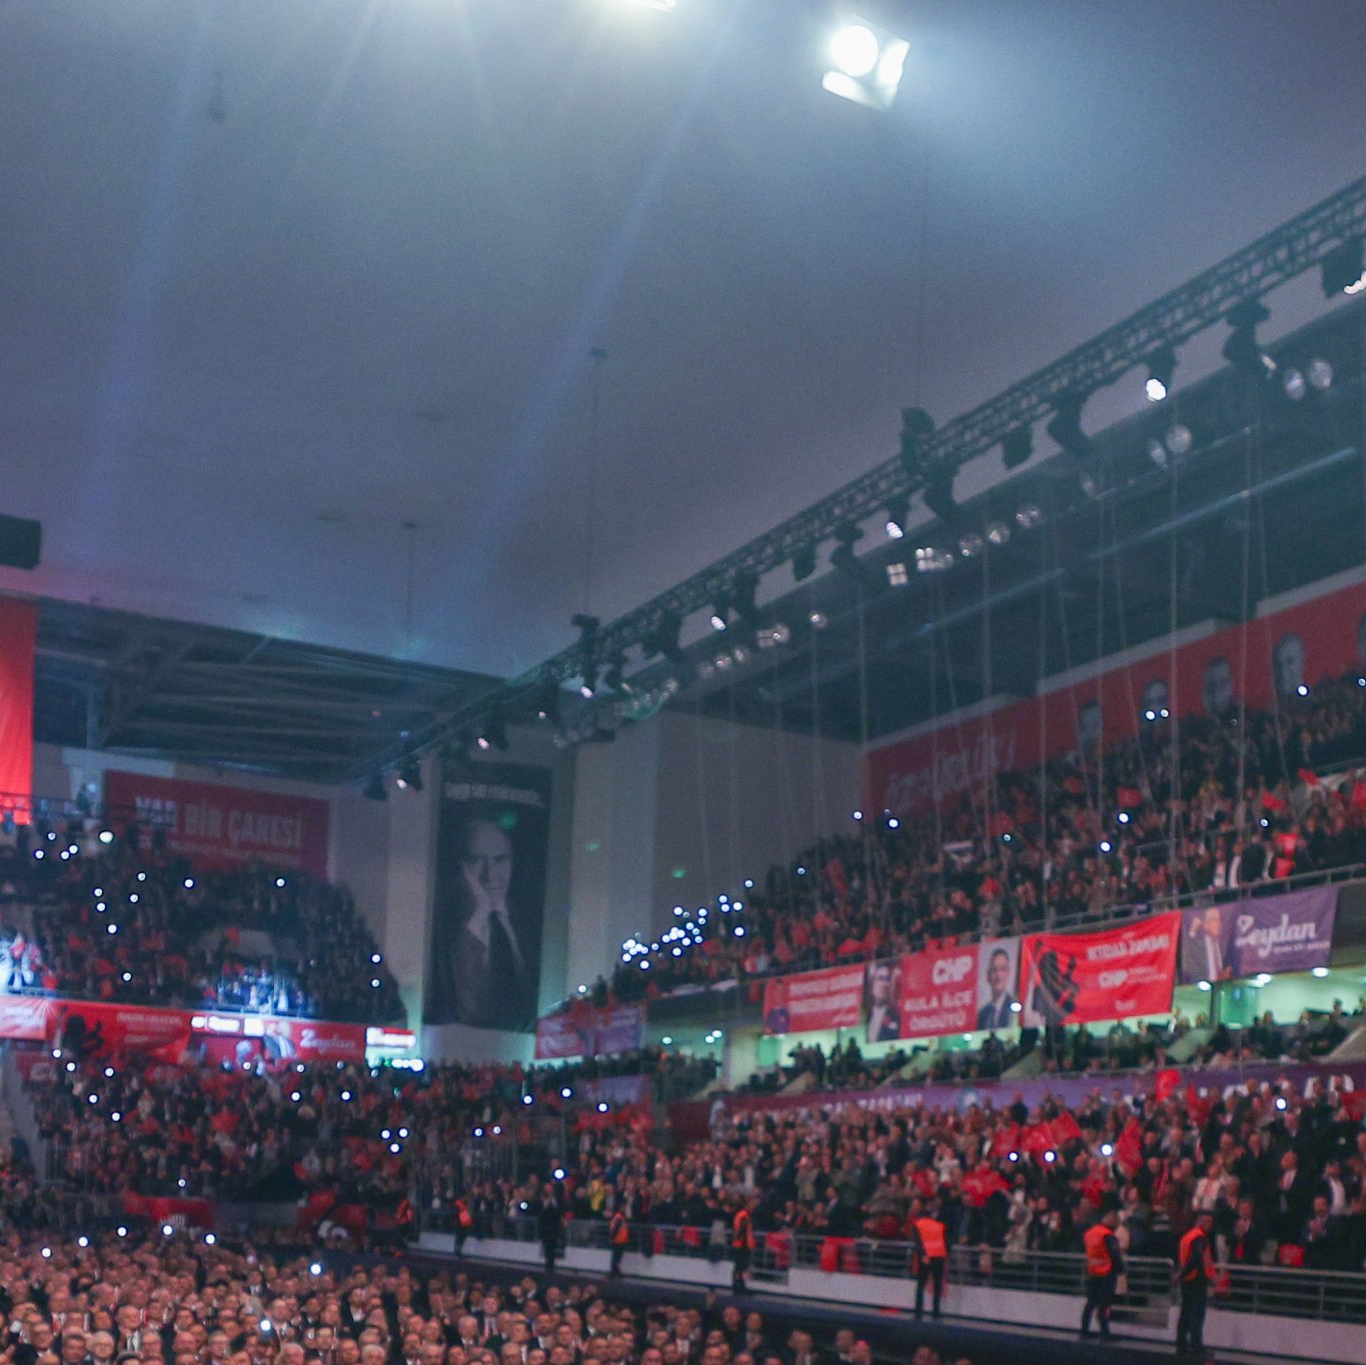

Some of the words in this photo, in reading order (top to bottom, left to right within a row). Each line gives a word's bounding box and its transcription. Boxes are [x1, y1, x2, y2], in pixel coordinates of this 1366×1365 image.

[1234, 913, 1317, 958] Zeydan
[933, 955, 974, 985] CHP
[1098, 969, 1129, 989] CHP
